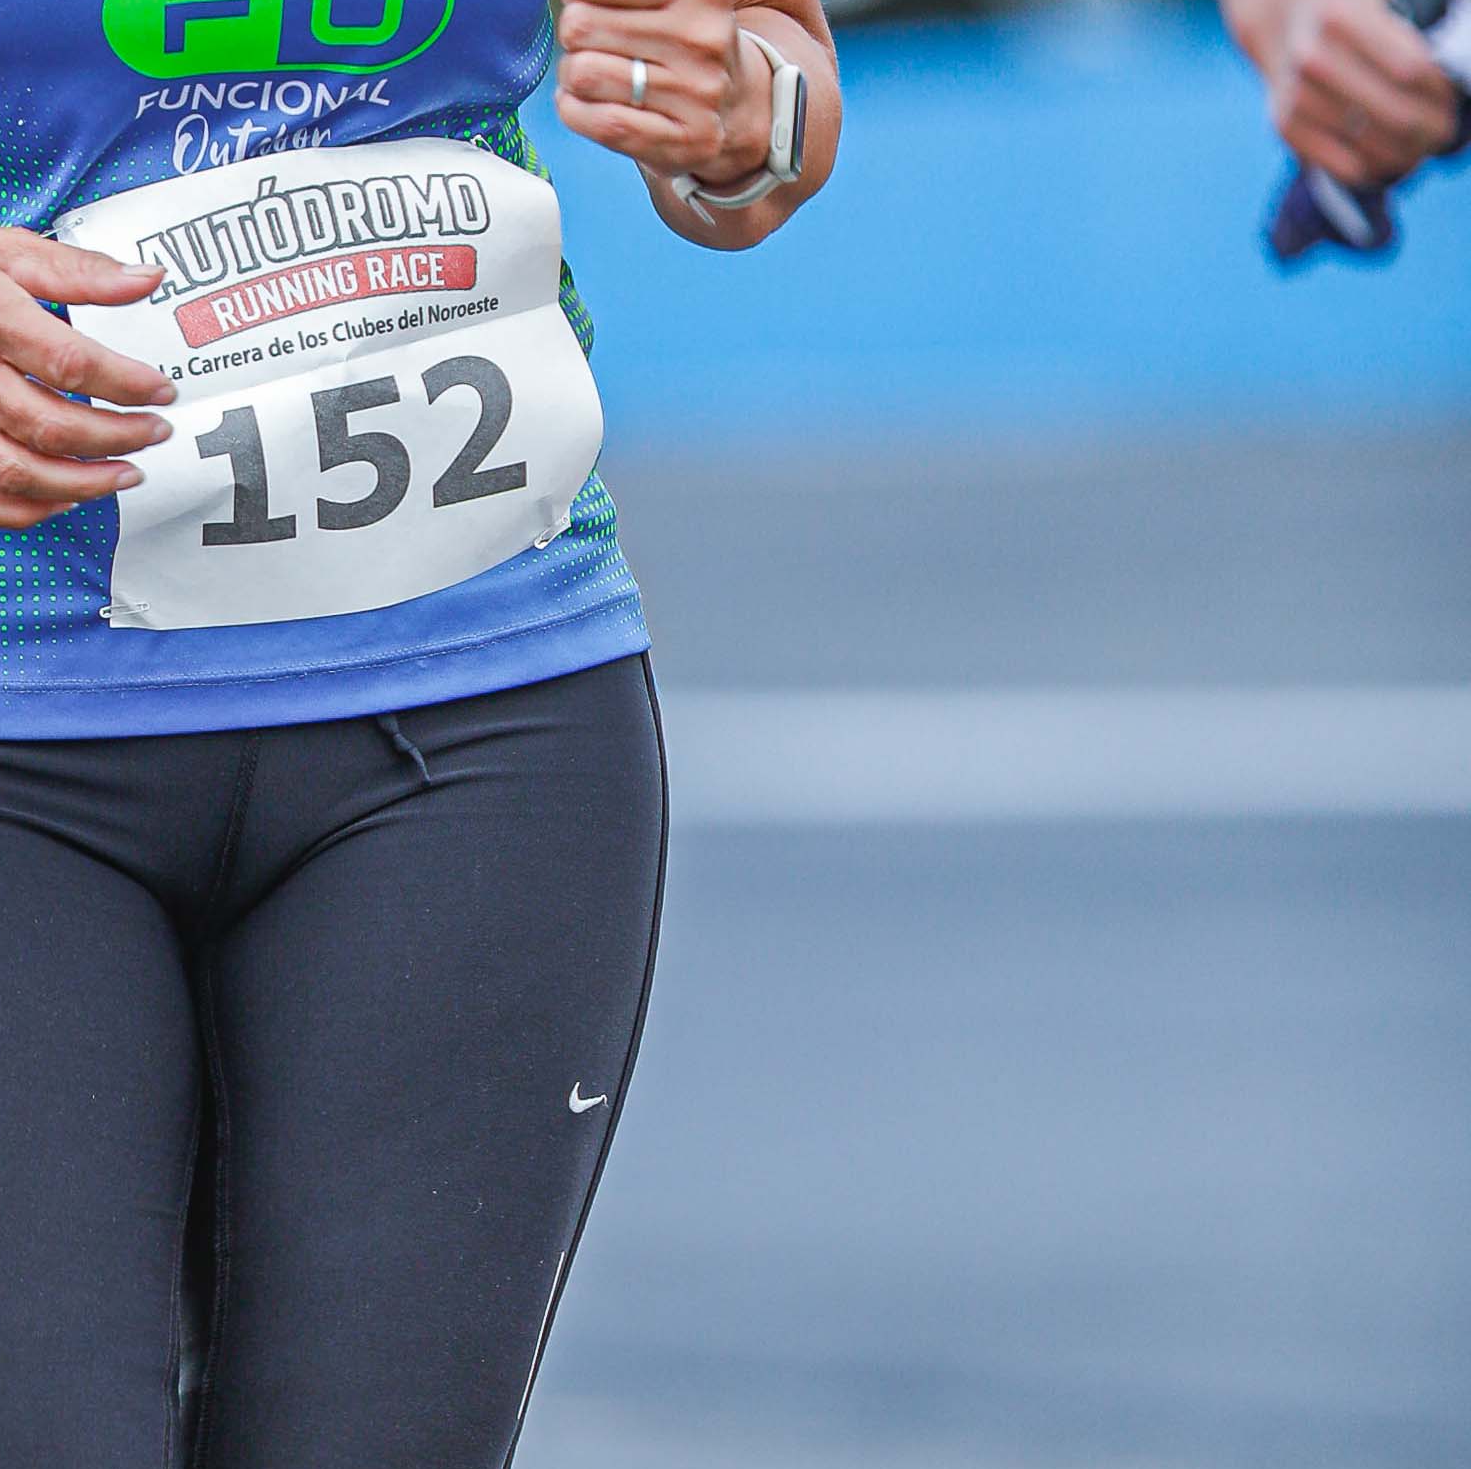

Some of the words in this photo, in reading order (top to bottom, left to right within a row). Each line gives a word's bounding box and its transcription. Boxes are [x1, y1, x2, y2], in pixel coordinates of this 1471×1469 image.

[135, 78, 391, 119] FUNCIONAL
[136, 173, 491, 305] AUTÓDROMO
[210, 260, 358, 334] RUNNING
[366, 251, 445, 292] RACE
[188, 346, 264, 377] Carrera
[268, 334, 294, 356] de
[299, 329, 328, 351] los
[332, 317, 394, 343] Clubes
[397, 308, 425, 330] del
[428, 295, 499, 325] Noroeste
[195, 355, 527, 546] 152
